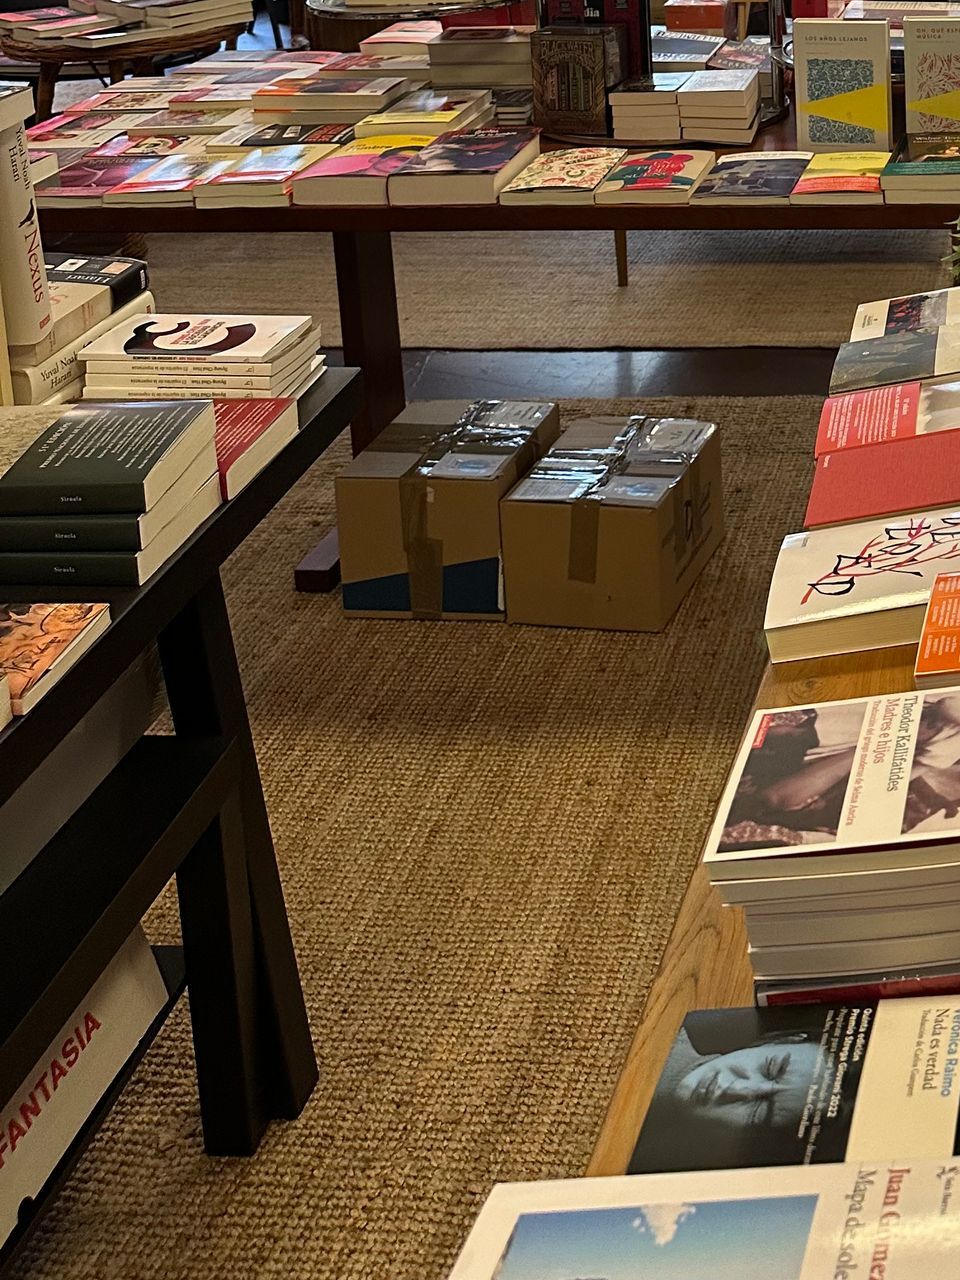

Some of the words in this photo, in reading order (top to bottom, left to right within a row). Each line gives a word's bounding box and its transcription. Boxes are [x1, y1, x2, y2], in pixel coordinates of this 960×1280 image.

[540, 40, 596, 59] BLACKWATER
[8, 146, 20, 183] Harari
[15, 125, 24, 157] Yuval
[20, 158, 31, 190] Noah
[24, 230, 44, 304] Nexus
[40, 363, 61, 381] Yuval
[50, 370, 72, 389] Harari
[867, 699, 881, 727] Traducción
[879, 698, 900, 731] Madres
[897, 695, 919, 734] Theodor
[860, 735, 872, 752] griego
[873, 740, 887, 765] hijos
[855, 752, 869, 777] moderno
[886, 733, 912, 793] Kallifatides
[850, 785, 862, 803] Selma
[846, 1008, 860, 1034] Premio
[860, 1007, 873, 1033] Quinta
[915, 1009, 931, 1039] Traducción
[931, 1008, 951, 1037] Nada
[839, 1035, 852, 1062] Strega
[852, 1034, 867, 1063] edición
[929, 1038, 938, 1050] es
[832, 1062, 847, 1092] Giovani
[921, 1050, 938, 1091] verdad
[940, 1058, 959, 1097] Raimo
[826, 1093, 839, 1119] 2022
[845, 1168, 878, 1212] Mapa
[883, 1167, 911, 1206] Juan
